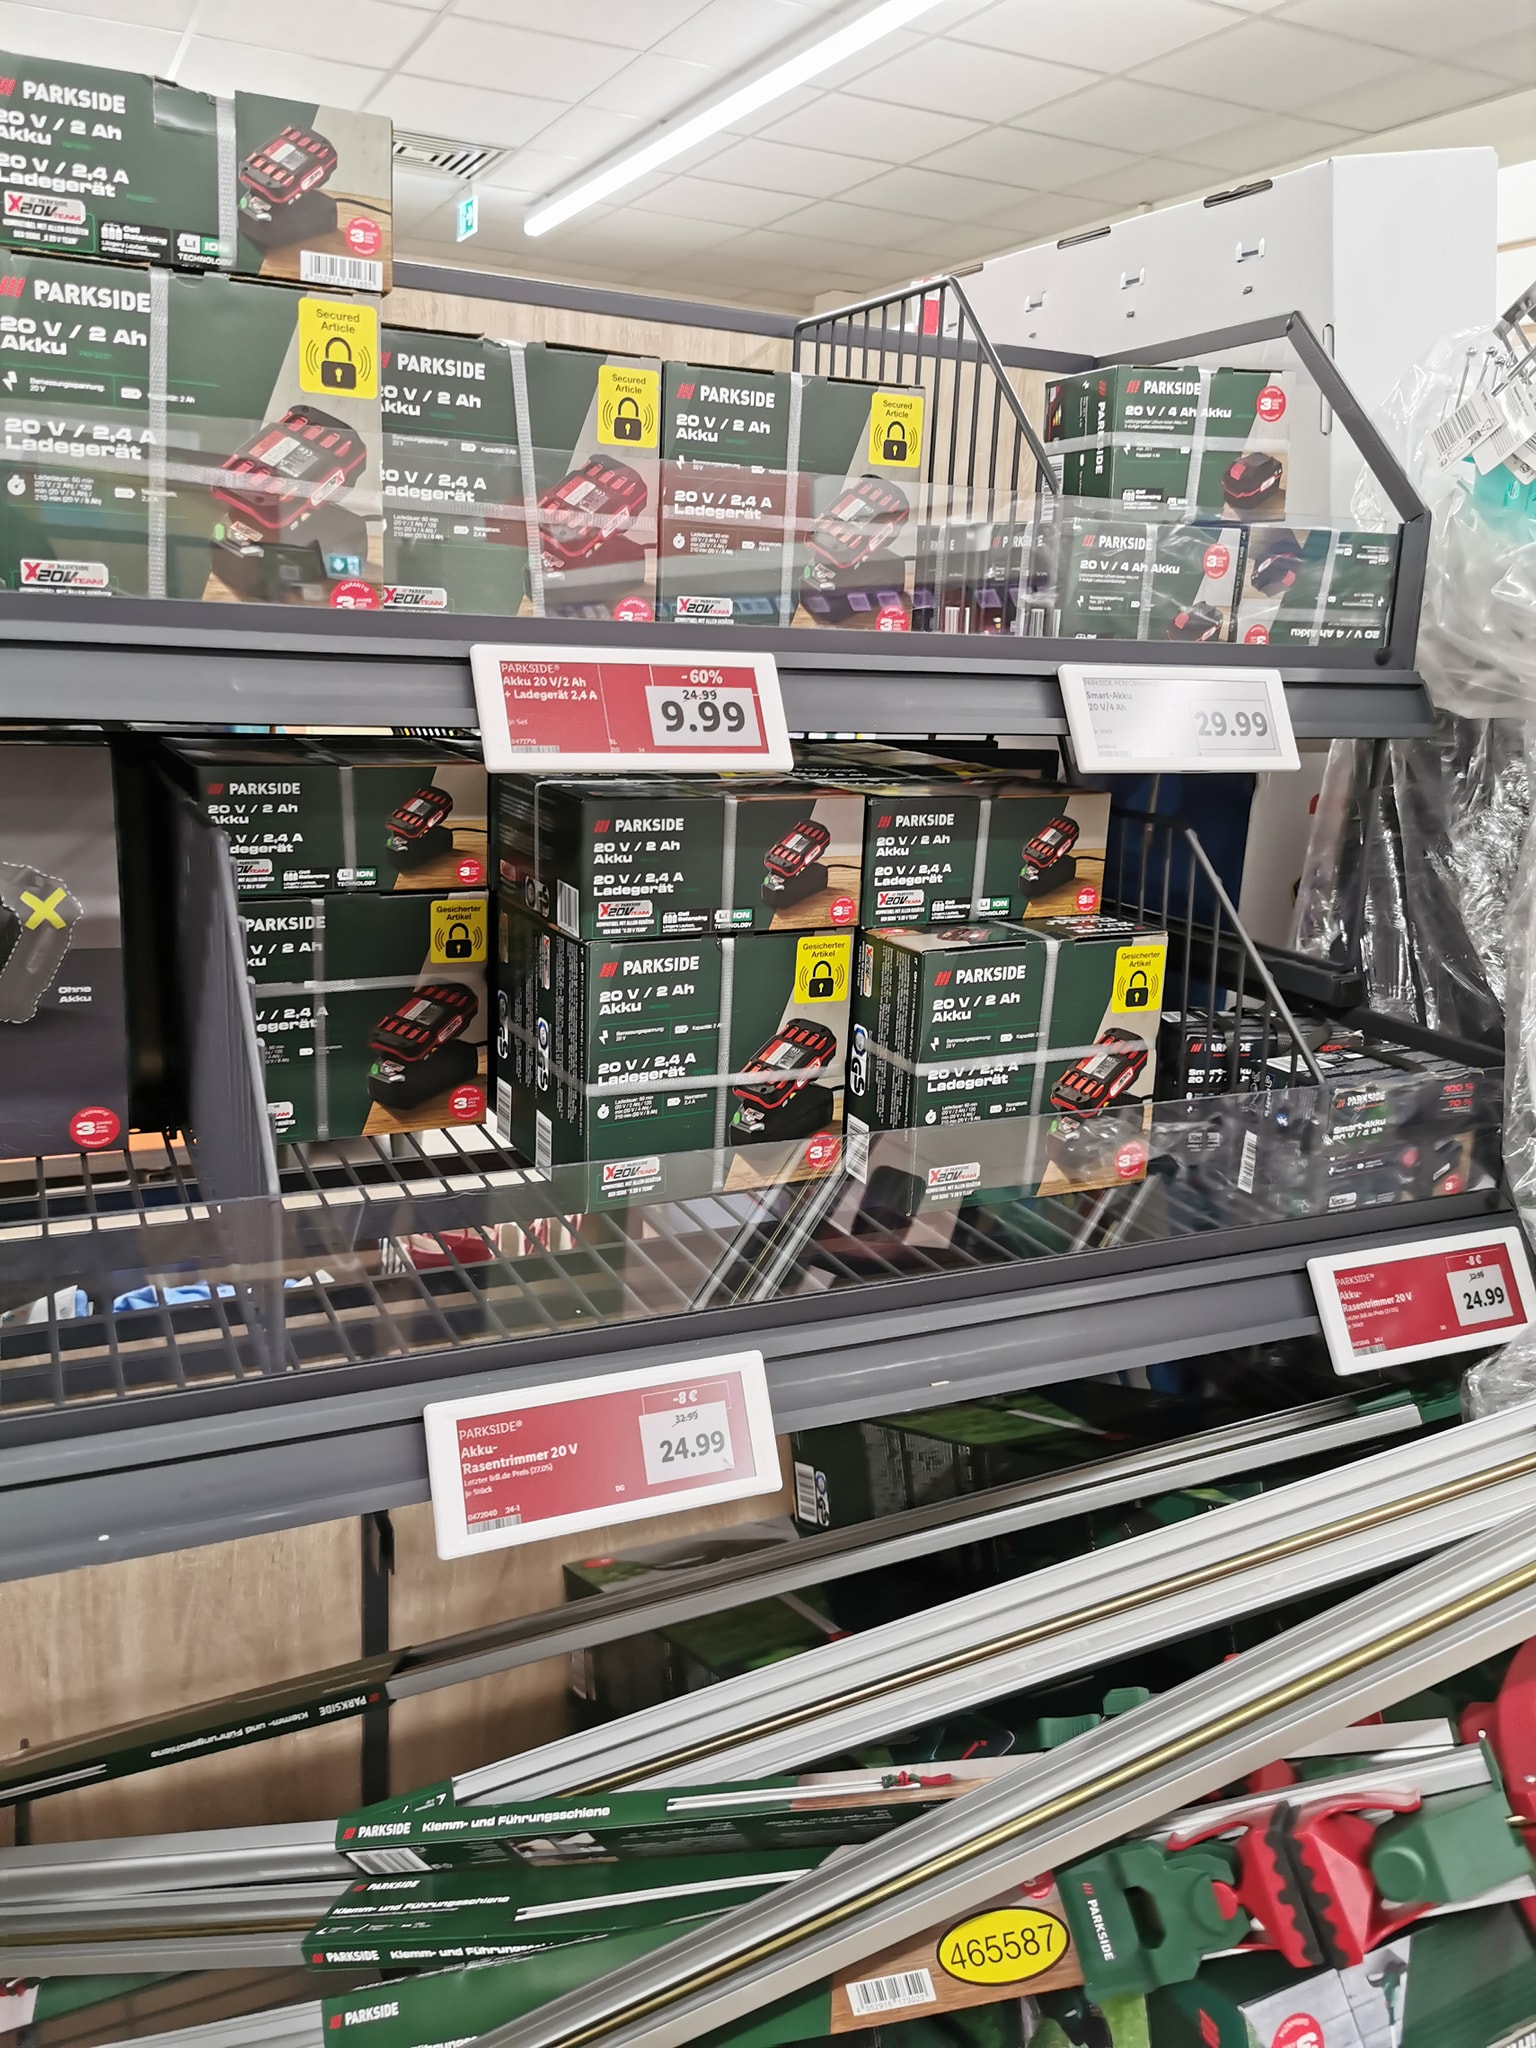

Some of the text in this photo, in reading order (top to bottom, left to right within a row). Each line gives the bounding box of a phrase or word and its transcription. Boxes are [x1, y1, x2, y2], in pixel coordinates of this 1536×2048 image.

[23, 80, 126, 114] PARKSIDE
[0, 126, 51, 145] Akku
[92, 124, 122, 141] Ah
[72, 163, 108, 181] 2,4
[0, 169, 116, 199] Ladegerät
[34, 280, 151, 313] PARKSIDE
[316, 308, 360, 323] Secured
[0, 316, 147, 347] 20 Ah
[321, 321, 356, 334] Article
[0, 334, 68, 356] Akku
[397, 353, 486, 381] PARKSIDE
[612, 373, 646, 385] Secured
[615, 384, 643, 395] Article
[1143, 380, 1201, 397] PARKSIDE
[456, 394, 482, 409] Ah
[700, 385, 776, 409] PARKSIDE
[883, 400, 913, 411] Secured
[1125, 405, 1233, 419] 20 Ah Akku
[885, 409, 909, 419] Article
[5, 418, 132, 443] 20 2,4
[676, 414, 771, 434] 20 Ah
[675, 429, 719, 443] Akku
[6, 435, 141, 461] Ladegerät
[438, 474, 469, 489] 2,4
[674, 490, 757, 508] 20 2,4
[674, 503, 762, 520] Ladegerät
[1080, 560, 1181, 575] 20 Ah Akku
[1290, 629, 1380, 638] 20 Akku
[501, 663, 560, 674] PARKSIDE®
[503, 676, 587, 689] Akku 20 V/2 Ah
[681, 669, 723, 685] -60%
[514, 688, 569, 702] Ladegerät
[571, 689, 588, 702] 2,4
[589, 690, 598, 700] A
[682, 689, 718, 701] 24.99
[1086, 691, 1132, 700] Smart-Akku
[1088, 702, 1127, 712] 20 V/4 Ah
[661, 700, 746, 733] 9.99
[1194, 711, 1268, 737] 29.99
[229, 783, 301, 796] PARKSIDE
[208, 803, 298, 815] 20 Ah
[615, 818, 684, 833] PARKSIDE
[895, 813, 955, 828] PARKSIDE
[263, 833, 289, 844] 2,4
[876, 834, 950, 847] 20 Ah
[593, 840, 681, 853] 20 Ah
[875, 846, 910, 857] Akku
[593, 853, 633, 865] Akku
[874, 863, 940, 877] 20 2,4
[593, 872, 671, 886] 20 2,4
[874, 873, 943, 887] Ladegerät
[593, 884, 674, 898] Ladegerät
[436, 905, 481, 914] Gesicherter
[992, 900, 1008, 908] ION
[446, 913, 472, 921] Artikel
[733, 911, 750, 919] ION
[245, 916, 326, 932] PARKSIDE
[714, 921, 753, 930] TECHNOLOGY
[299, 941, 323, 953] Ah
[802, 942, 845, 951] Gesicherter
[811, 950, 836, 958] Artikel
[1121, 951, 1161, 960] Gesicherter
[623, 956, 700, 977] PARKSIDE
[1129, 959, 1152, 968] Artikel
[955, 965, 1027, 984] PARKSIDE
[58, 985, 92, 994] Ohne
[599, 983, 695, 1003] 20 Ah
[59, 994, 92, 1004] Akku
[932, 992, 1020, 1011] 20 Ah
[284, 1007, 312, 1020] 2,4
[599, 1001, 642, 1016] Akku
[932, 1010, 972, 1023] Akku
[598, 1055, 682, 1075] 20 2,4
[598, 1066, 686, 1088] Ladegerät
[927, 1069, 950, 1081] 20
[927, 1074, 1009, 1093] Ladegerät
[1465, 1255, 1475, 1265] -8
[1339, 1291, 1362, 1300] Akku-
[1342, 1291, 1412, 1313] Rasentrimmer 20 V
[1463, 1286, 1505, 1310] 24.99
[673, 1389, 699, 1404] -8 €
[460, 1444, 498, 1459] Akku-
[659, 1430, 726, 1463] 24.99
[462, 1443, 579, 1476] Rasentrimmer 20 V
[319, 1694, 368, 1717] PARKSIDE
[358, 1806, 611, 1839] PARKSIDE Klemm- und Führungsschiene
[366, 1879, 421, 1893] PARKSIDE
[332, 1895, 511, 1915] Klemm- und Führungsschiene
[1087, 1899, 1115, 1961] PARKSIDE
[325, 1946, 464, 1963] PARKSIDE Klemm- und
[950, 1924, 1054, 1971] 465587
[345, 2002, 400, 2027] PARKSIDE
